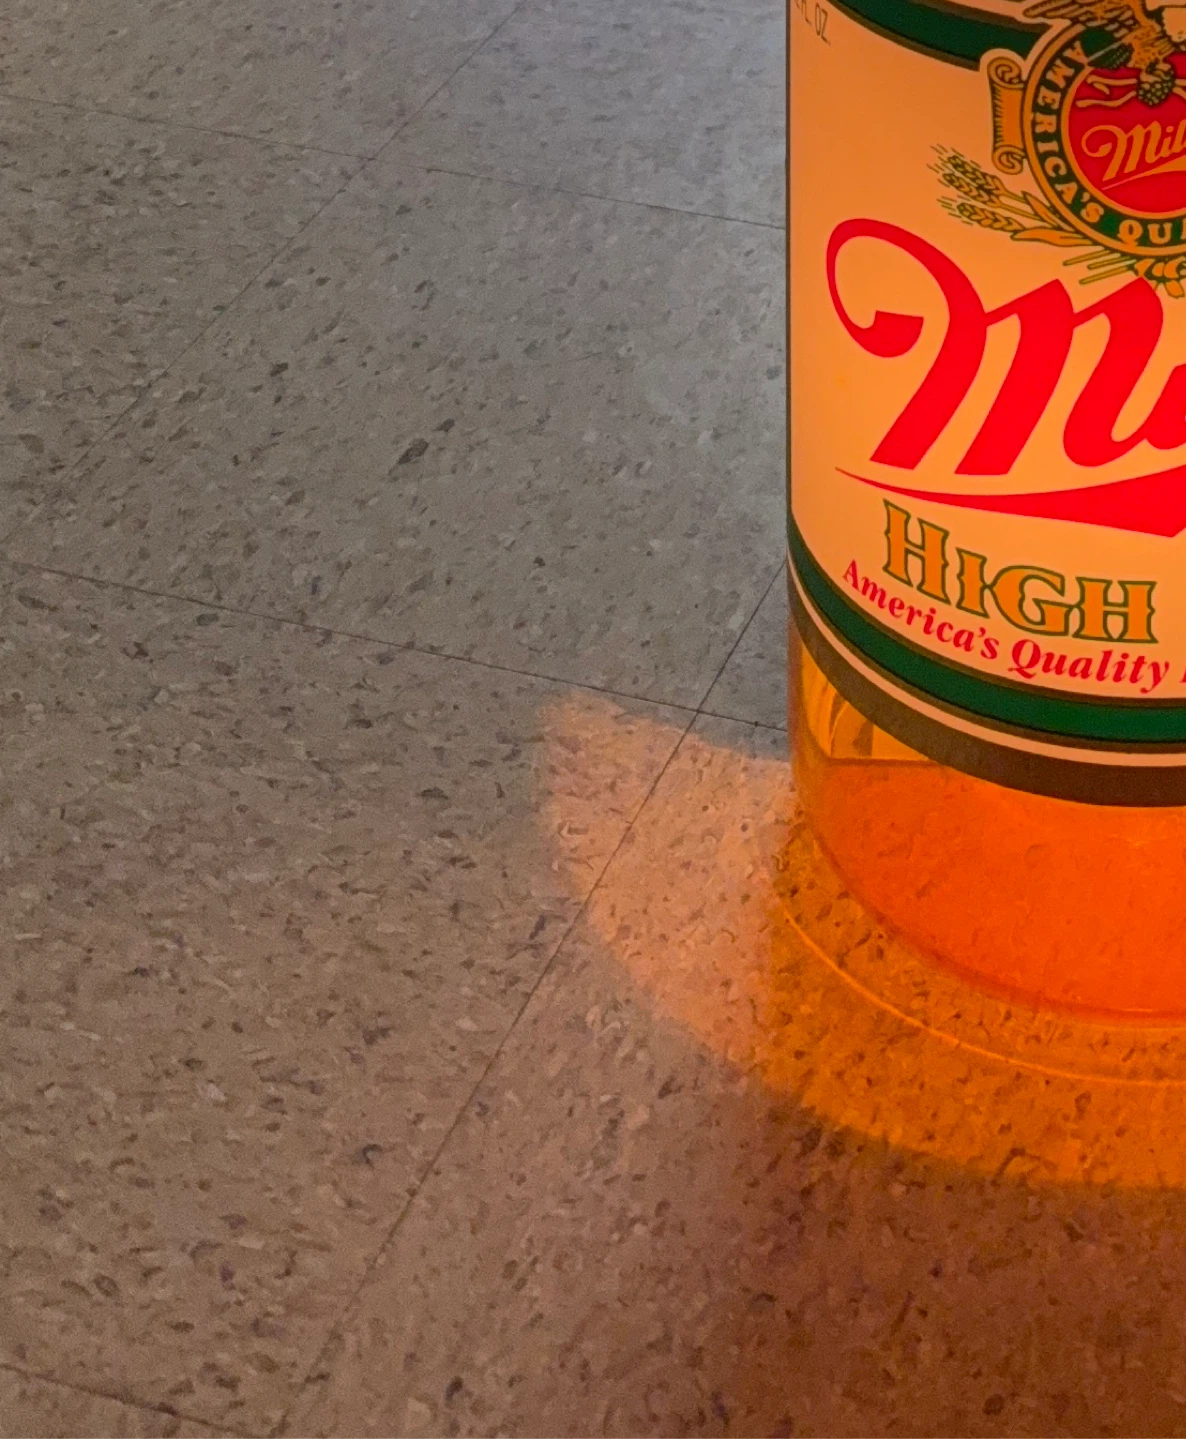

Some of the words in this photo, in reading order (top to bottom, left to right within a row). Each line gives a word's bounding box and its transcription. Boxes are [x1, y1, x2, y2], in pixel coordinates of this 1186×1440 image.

[1034, 40, 1104, 224] AMERICA'S
[842, 558, 1001, 662] America's
[1007, 637, 1170, 695] Quality
[882, 498, 1158, 645] HIGH
